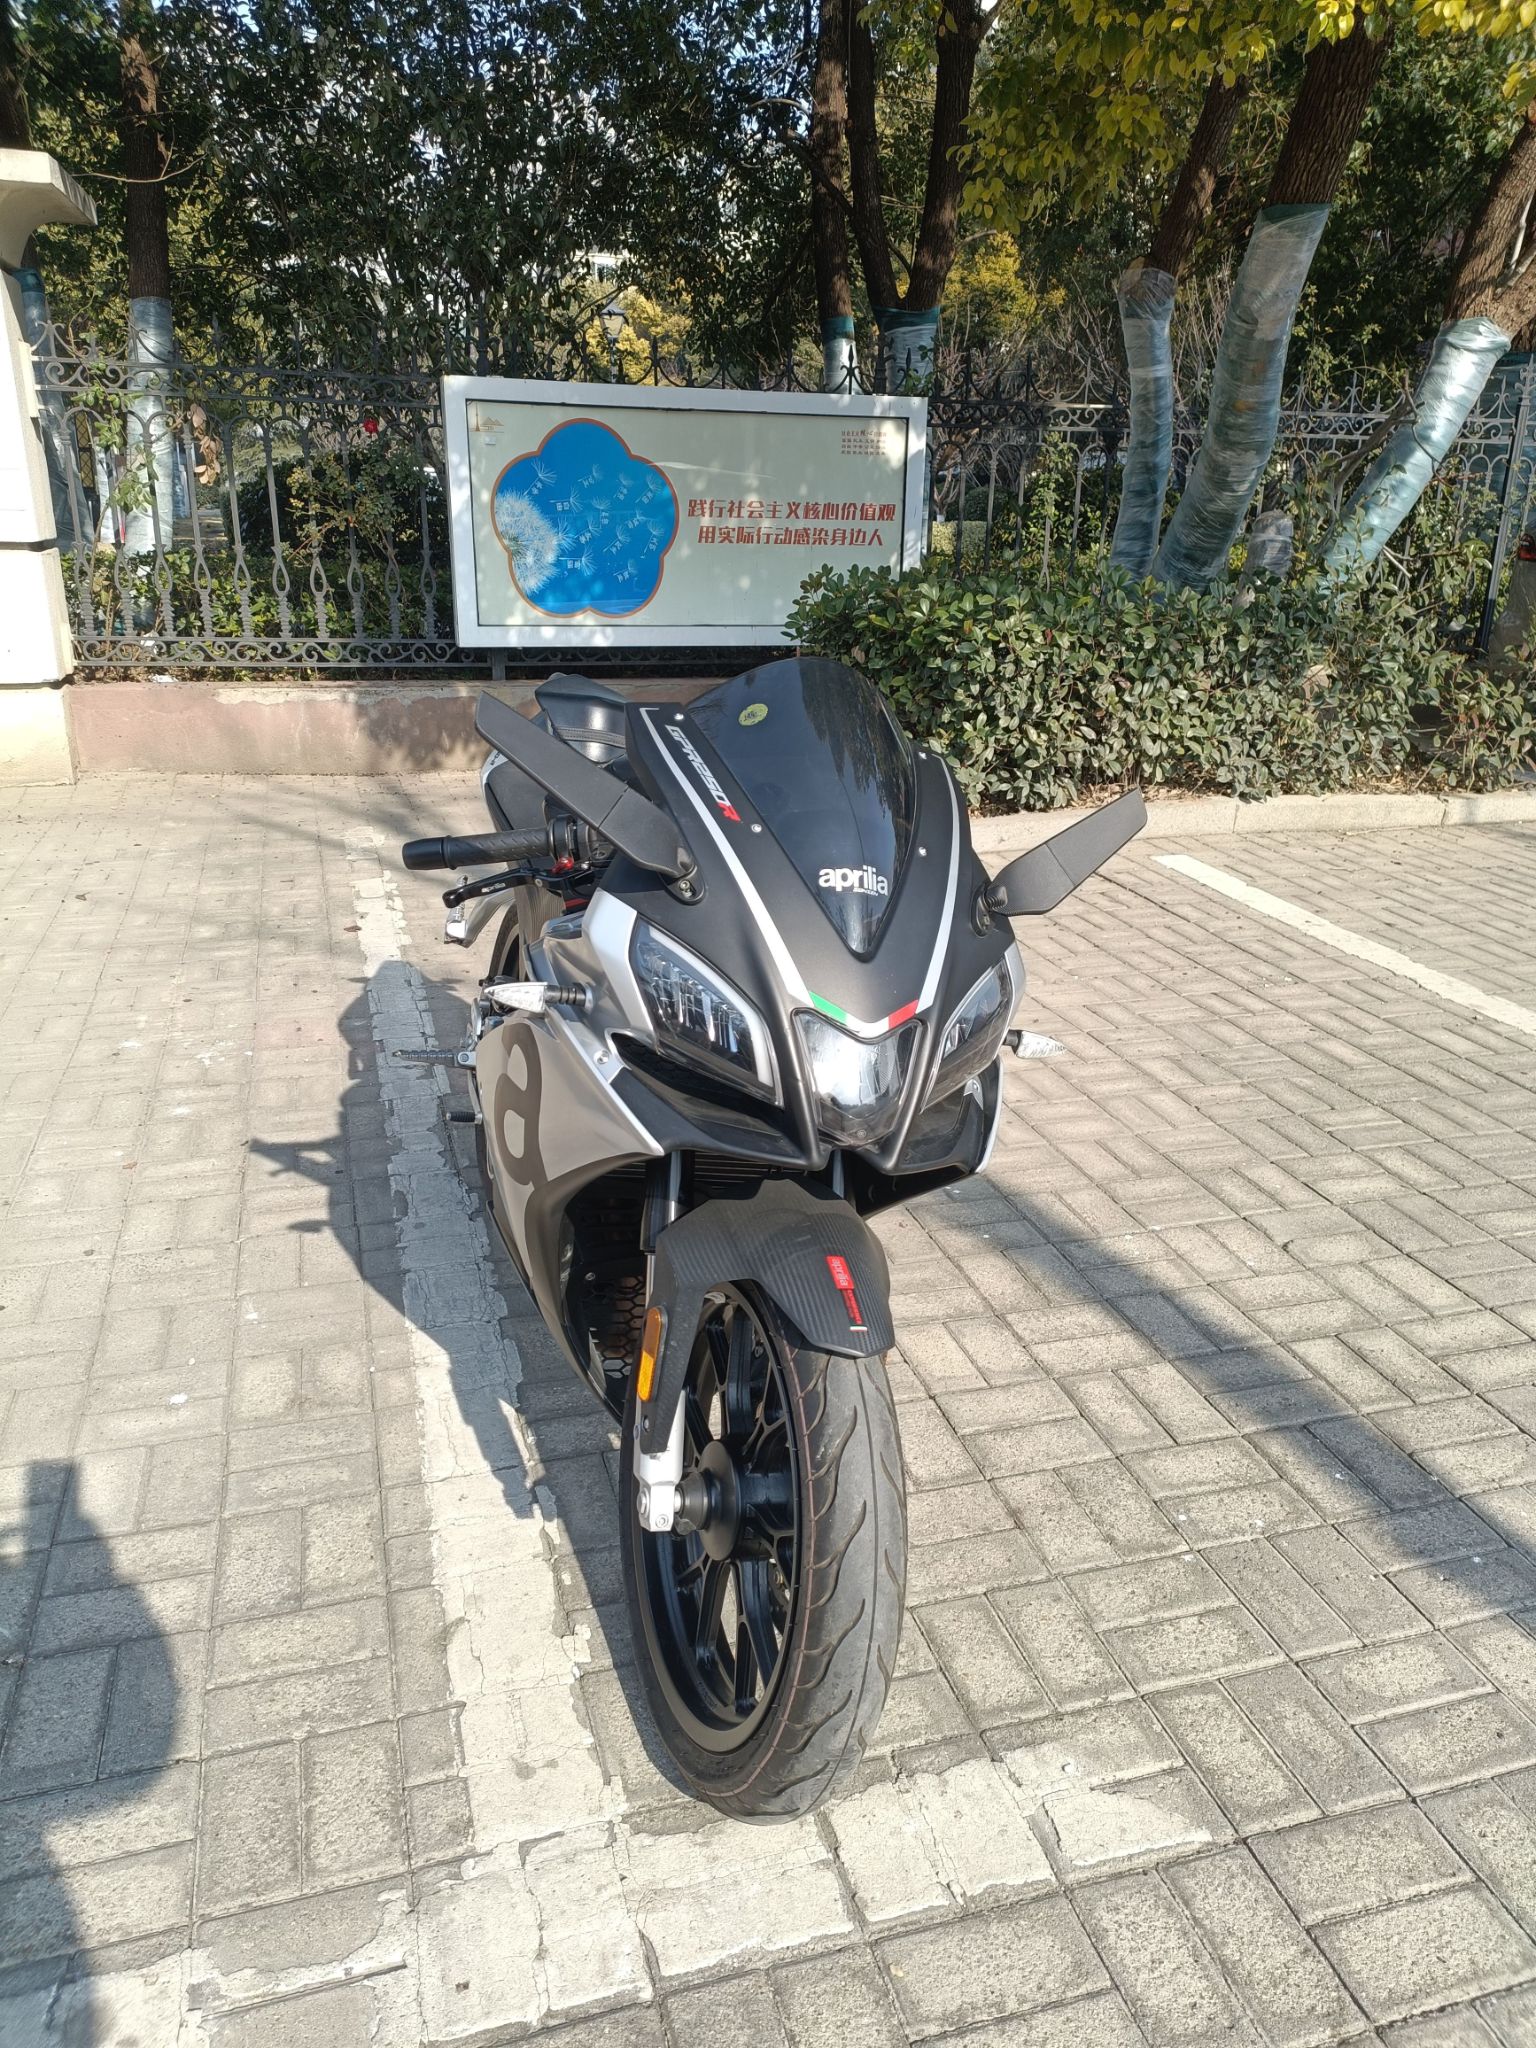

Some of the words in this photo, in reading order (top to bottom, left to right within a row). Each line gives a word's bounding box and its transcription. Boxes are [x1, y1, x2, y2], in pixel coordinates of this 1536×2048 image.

[687, 499, 896, 521] 践行社会主义核心价值观
[698, 526, 883, 546] 用实际行动感染身边人
[818, 864, 889, 896] aprilia
